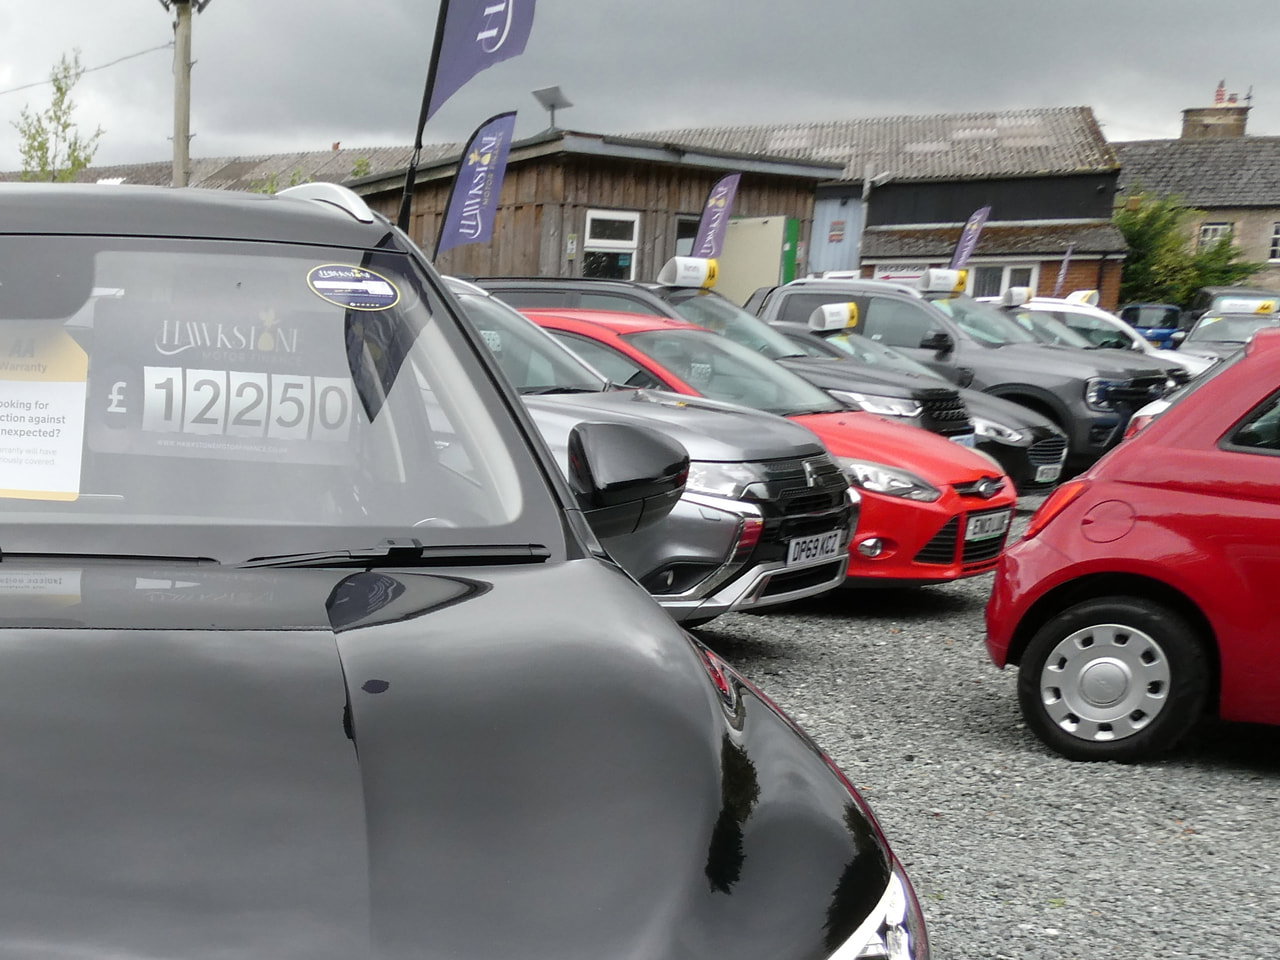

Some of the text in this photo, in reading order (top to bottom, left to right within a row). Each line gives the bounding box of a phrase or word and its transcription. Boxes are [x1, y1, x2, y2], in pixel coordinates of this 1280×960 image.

[34, 400, 50, 410] for
[107, 377, 348, 430] £ 12250
[28, 415, 66, 426] against
[25, 446, 38, 455] will
[39, 447, 57, 456] have
[792, 538, 820, 562] DP69
